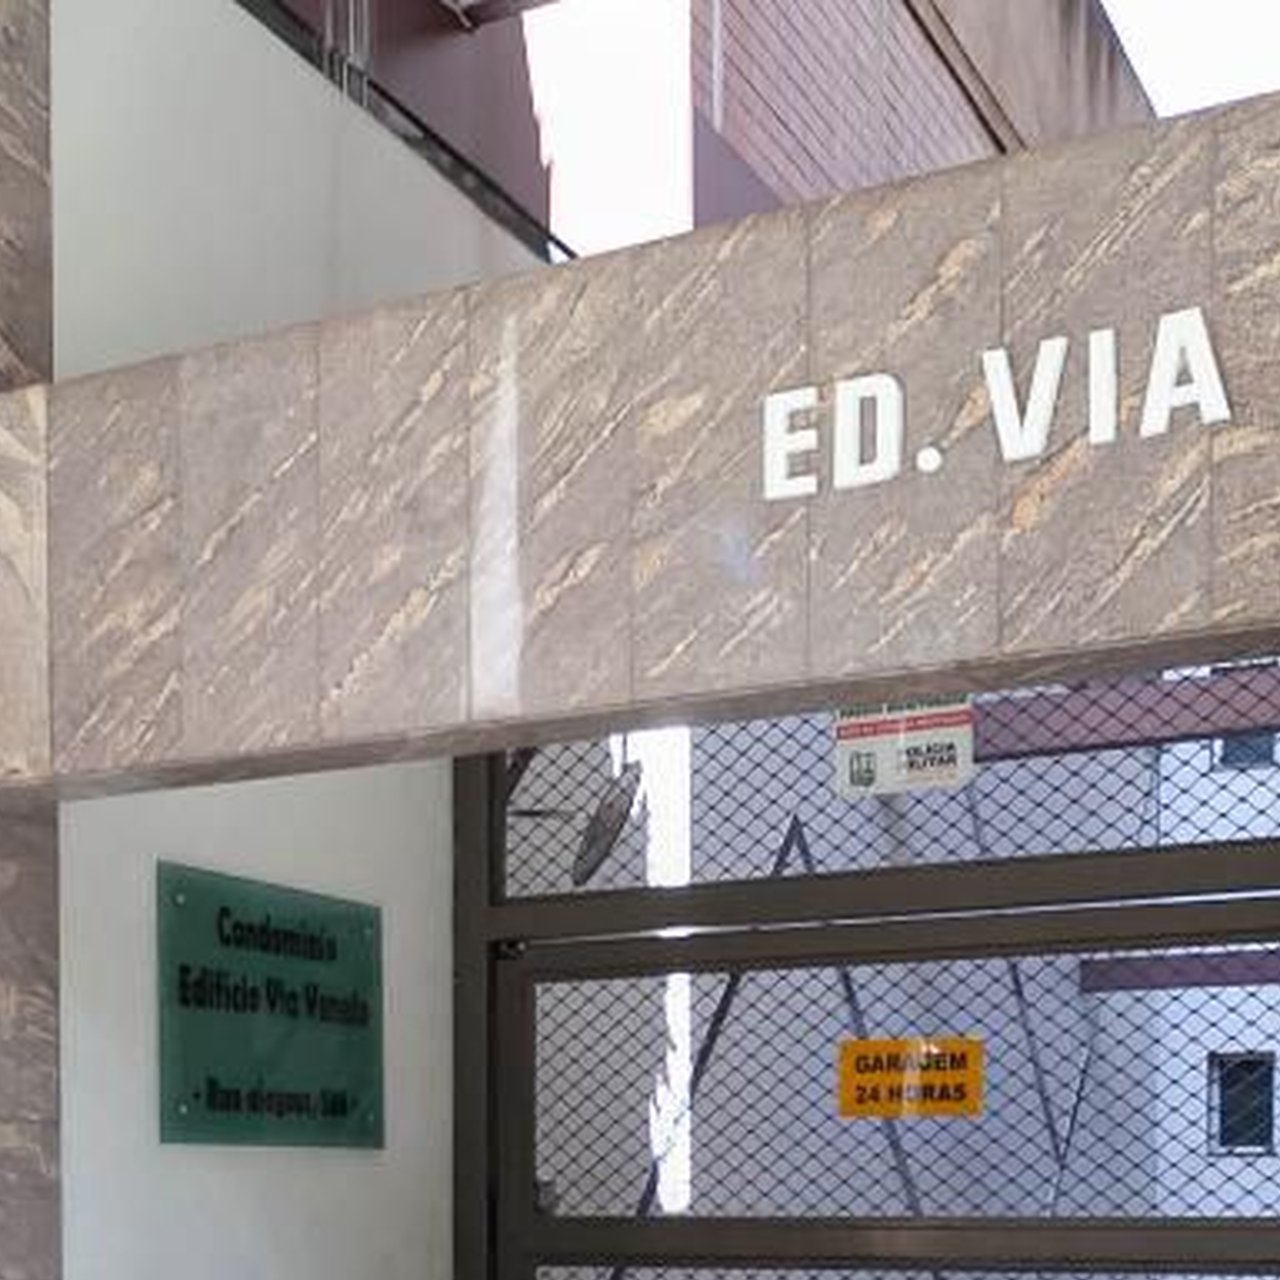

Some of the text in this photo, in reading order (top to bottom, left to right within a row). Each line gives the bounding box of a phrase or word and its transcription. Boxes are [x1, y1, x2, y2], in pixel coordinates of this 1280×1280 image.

[763, 373, 942, 501] ED.
[982, 306, 1231, 463] VIA
[856, 1083, 967, 1105] 24 HORAS
